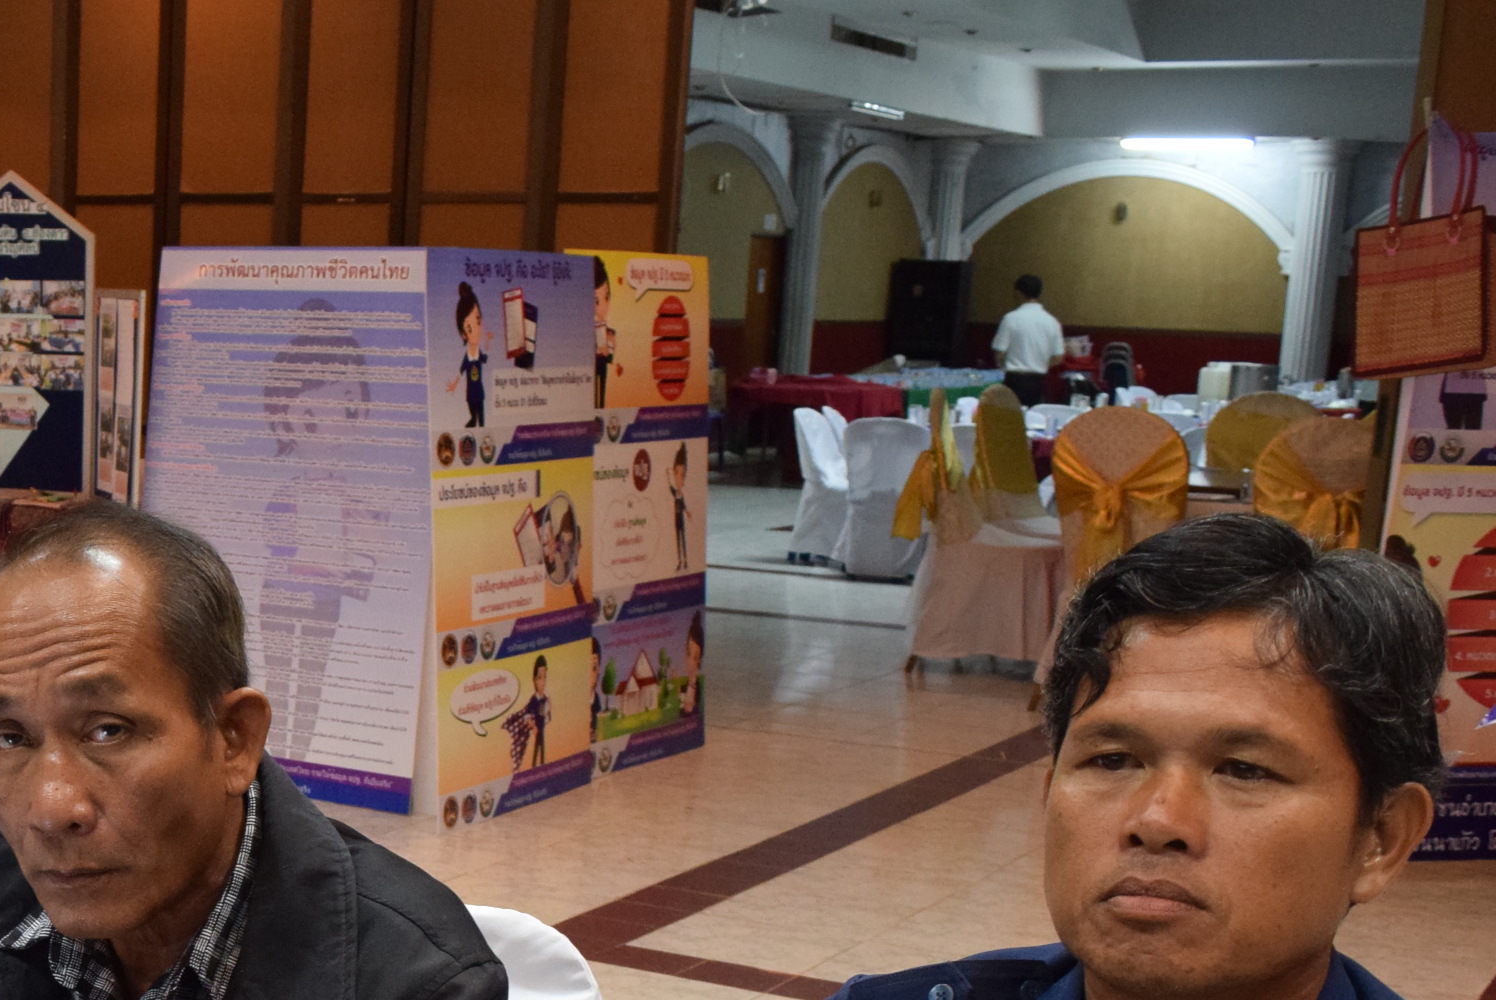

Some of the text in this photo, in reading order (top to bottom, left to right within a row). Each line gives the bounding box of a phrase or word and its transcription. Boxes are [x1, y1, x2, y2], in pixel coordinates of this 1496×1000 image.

[198, 257, 410, 285] การพัฒนาคุณภาพชีวิตคนไทย
